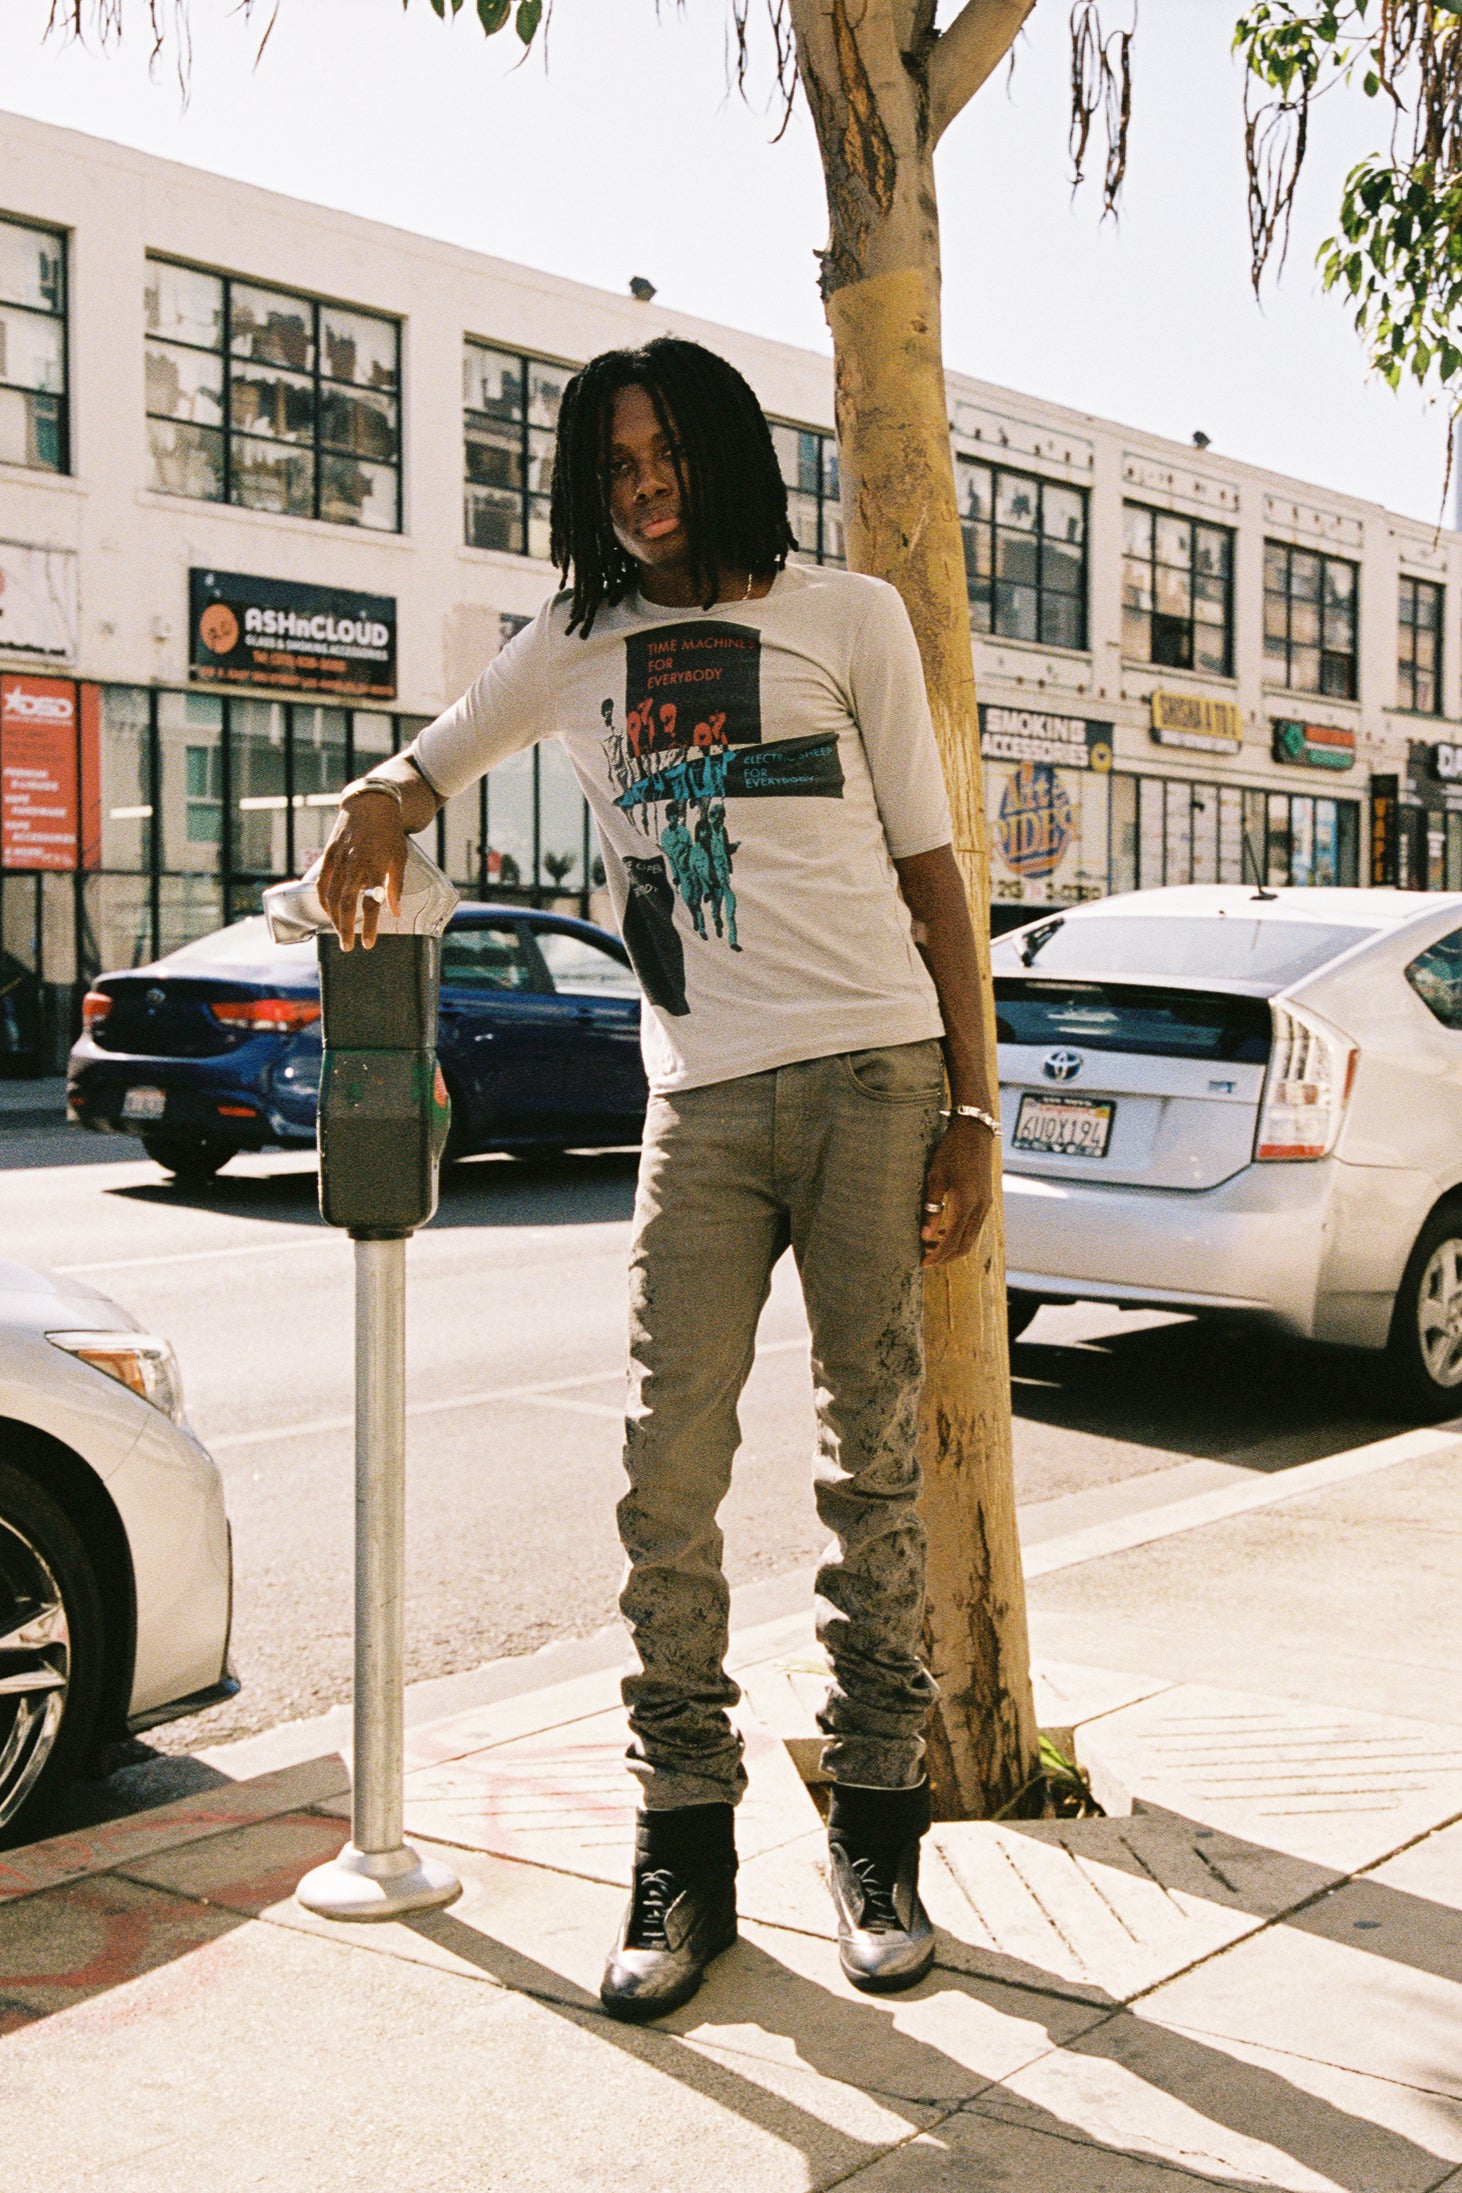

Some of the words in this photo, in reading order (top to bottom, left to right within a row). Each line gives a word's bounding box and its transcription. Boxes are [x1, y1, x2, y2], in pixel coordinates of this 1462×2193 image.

[245, 607, 389, 647] ASHnCLOUD
[647, 639, 678, 656] TIME
[681, 637, 756, 650] MACHINES
[648, 657, 673, 673] FOR
[647, 667, 722, 690] EVERYBODY
[744, 768, 768, 779] FOR
[745, 775, 815, 789] EVERYBODY
